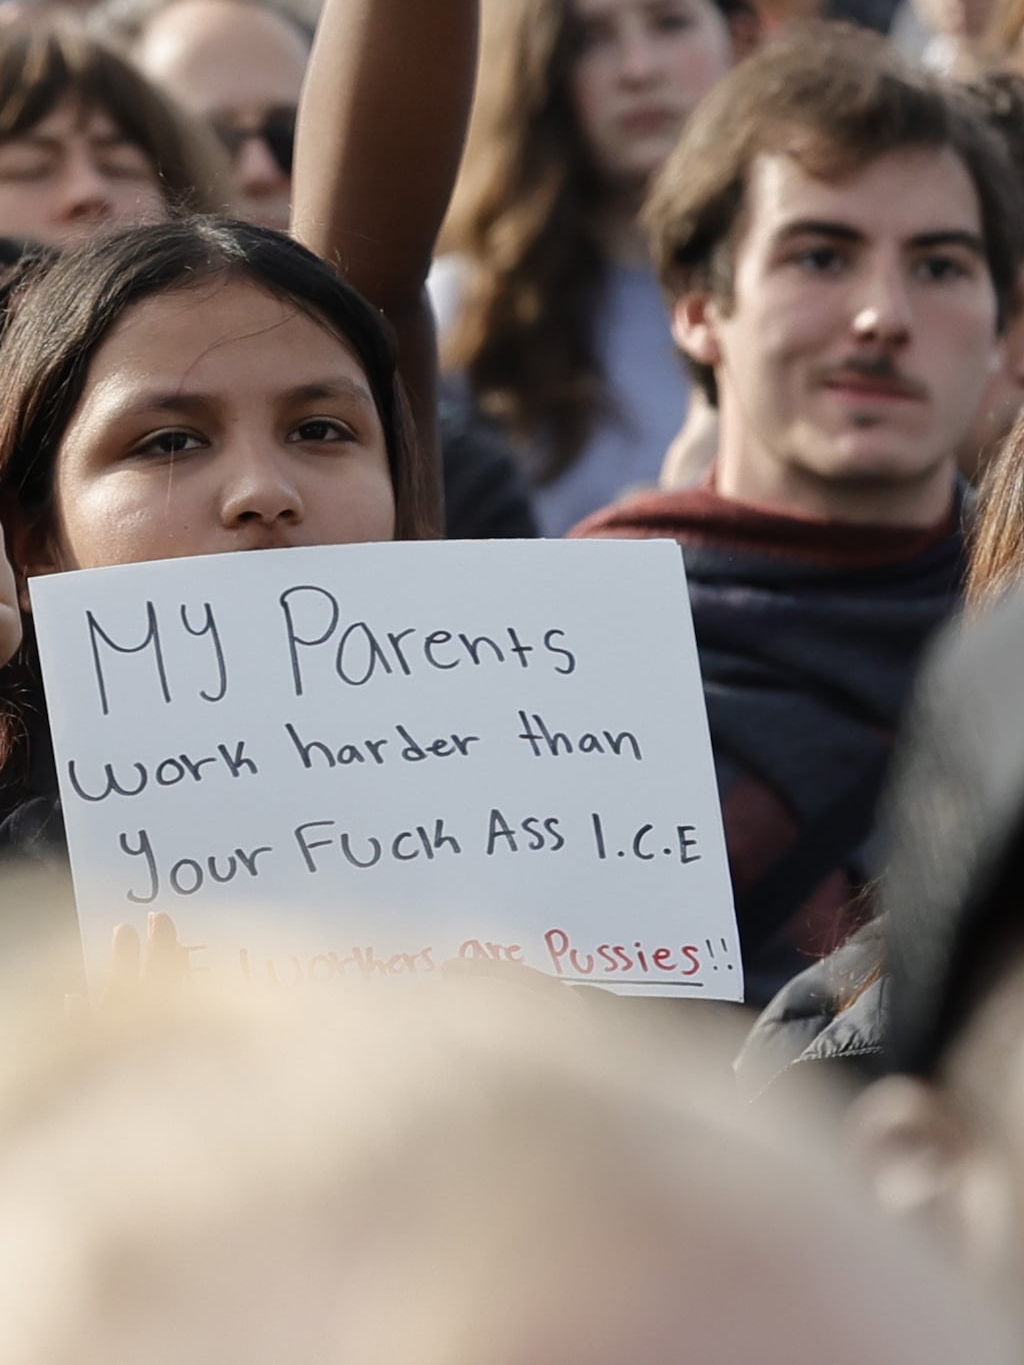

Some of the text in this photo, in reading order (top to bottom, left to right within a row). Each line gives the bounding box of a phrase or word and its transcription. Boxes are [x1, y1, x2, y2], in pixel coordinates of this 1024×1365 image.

[279, 585, 576, 697] Parents
[67, 709, 642, 802] work harder than
[118, 828, 273, 905] your
